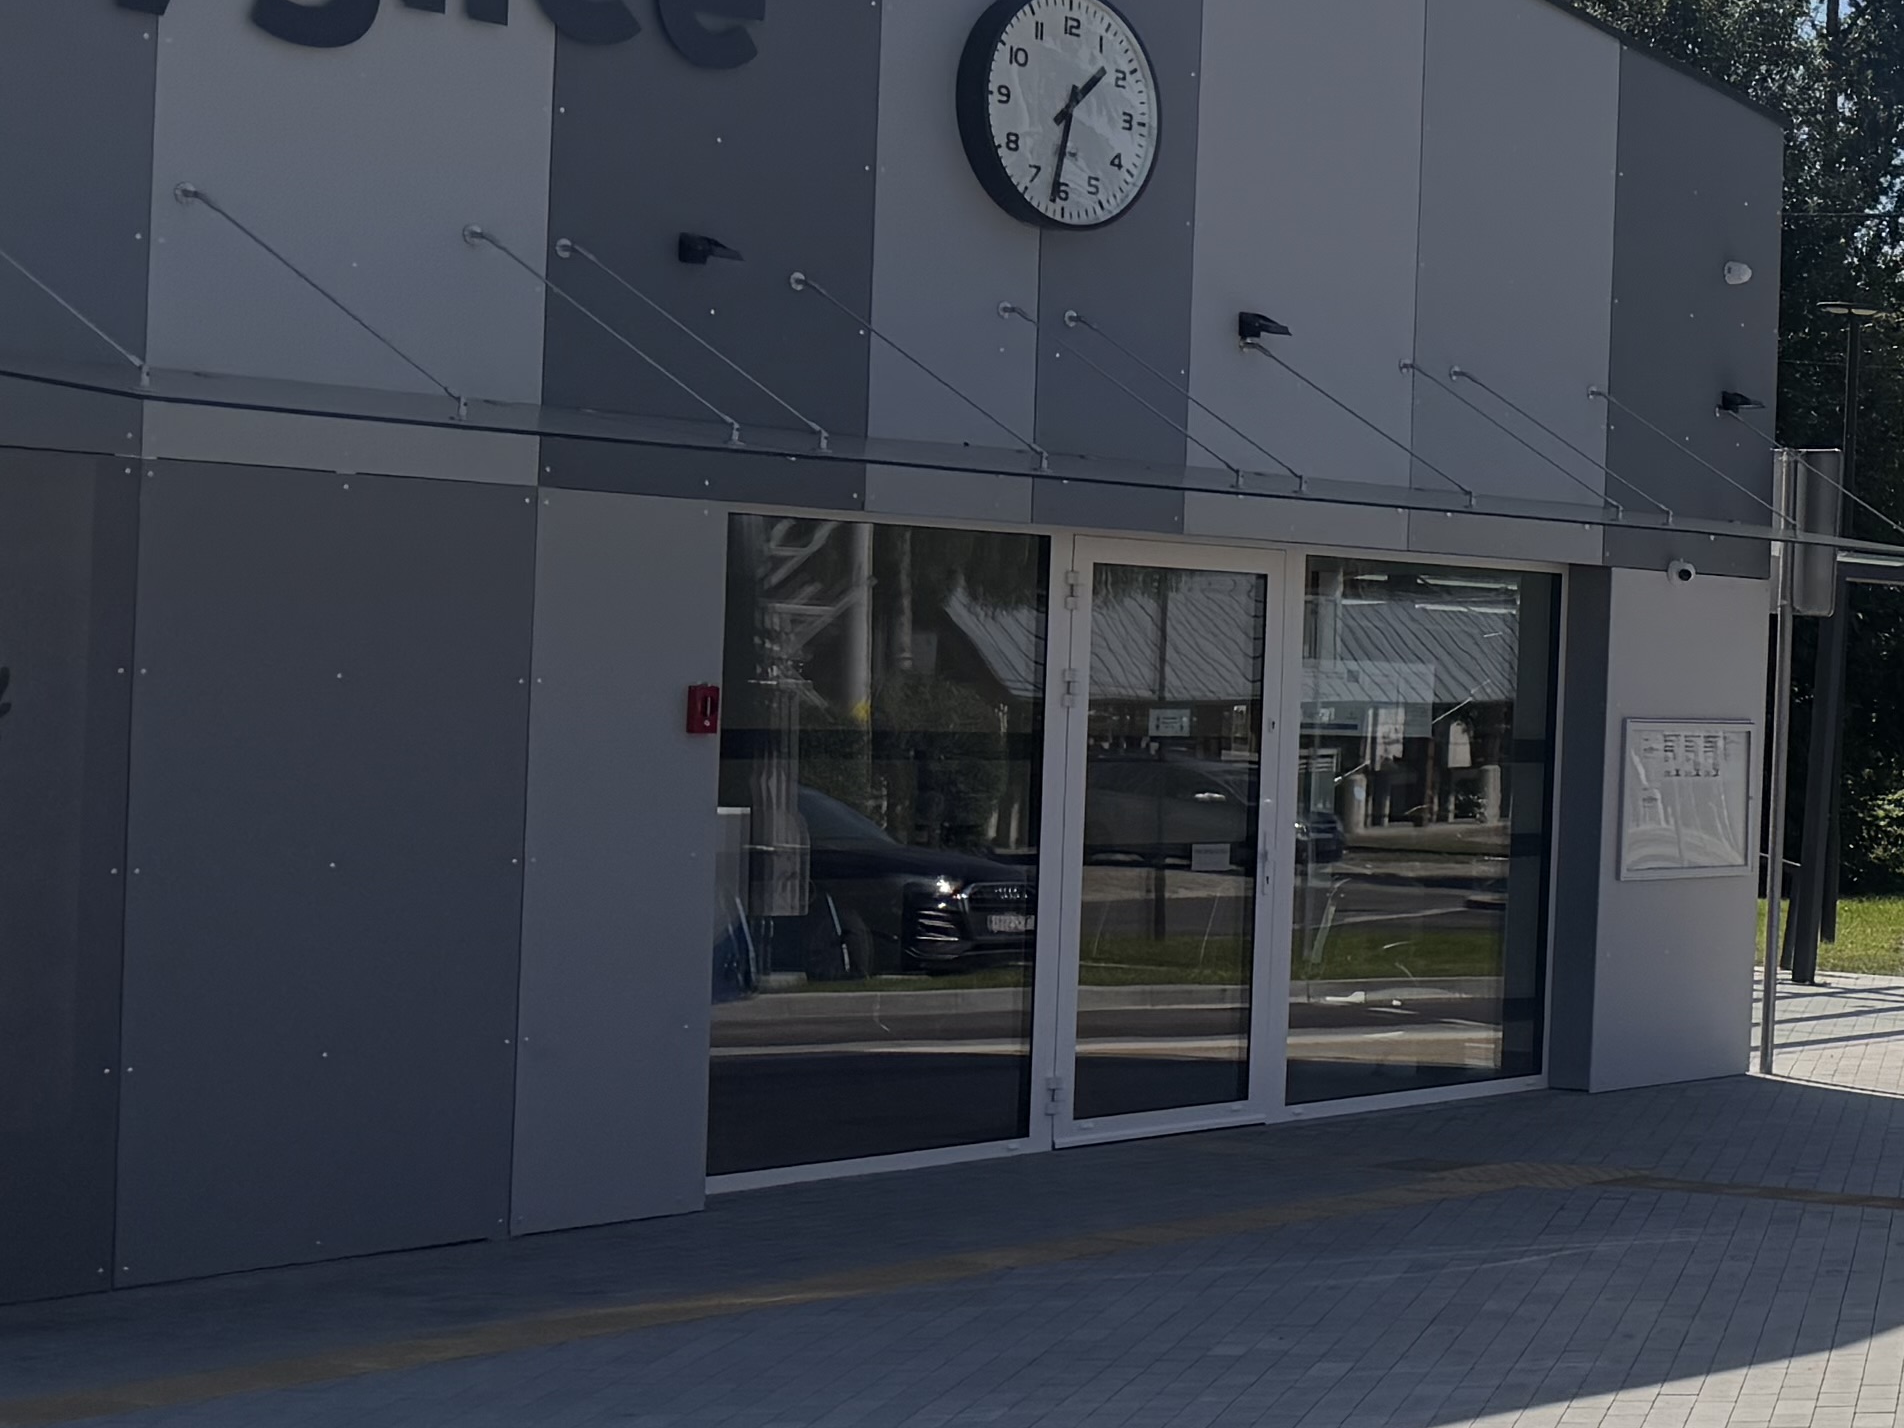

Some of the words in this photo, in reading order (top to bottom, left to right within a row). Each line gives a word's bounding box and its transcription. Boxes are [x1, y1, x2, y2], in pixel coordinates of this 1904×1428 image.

[1034, 21, 1044, 41] 11
[1064, 16, 1081, 37] 12
[1009, 45, 1029, 67] 10
[1114, 69, 1127, 89] 2
[997, 85, 1011, 104] 9
[1121, 111, 1134, 131] 3
[1005, 132, 1020, 152] 8
[1110, 153, 1124, 170] 4
[1028, 164, 1041, 183] 7
[1055, 182, 1070, 202] 6
[1087, 176, 1100, 196] 5
